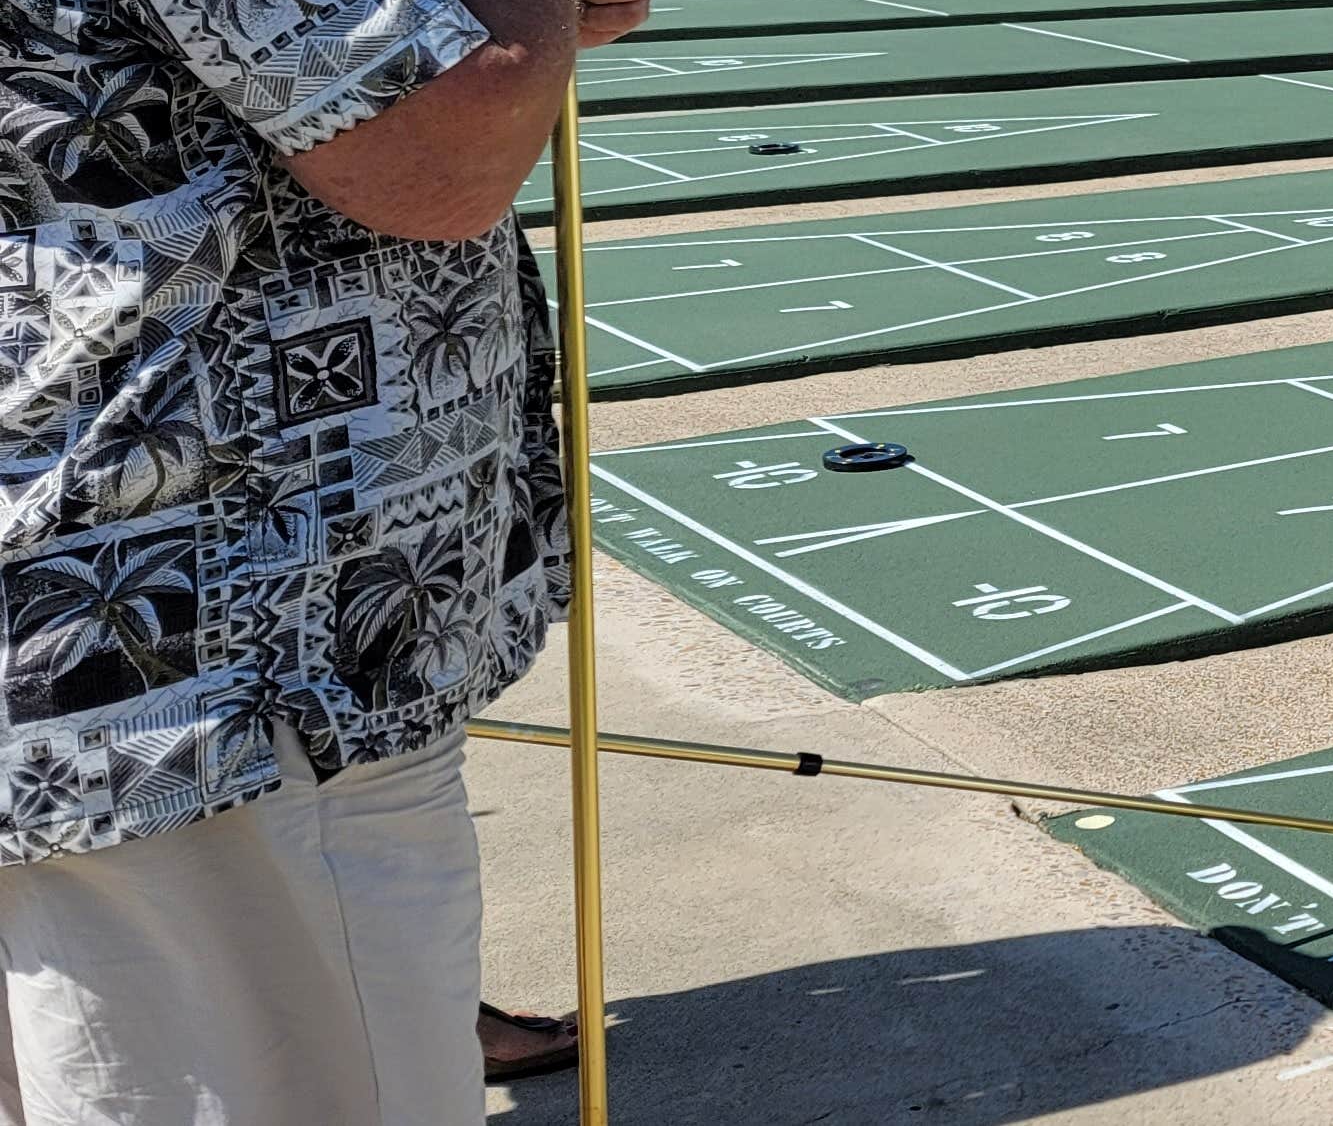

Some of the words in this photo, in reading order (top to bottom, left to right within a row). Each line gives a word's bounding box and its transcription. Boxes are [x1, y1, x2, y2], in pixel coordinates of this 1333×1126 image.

[1036, 231, 1095, 242] 8
[1106, 251, 1167, 263] 8
[672, 258, 743, 271] 7
[779, 300, 854, 313] 7
[1102, 423, 1188, 441] 7
[591, 498, 640, 524] ON'T
[623, 527, 700, 564] WALK
[690, 569, 744, 590] ON
[732, 594, 848, 650] COURTS
[1186, 861, 1325, 937] DON'T
